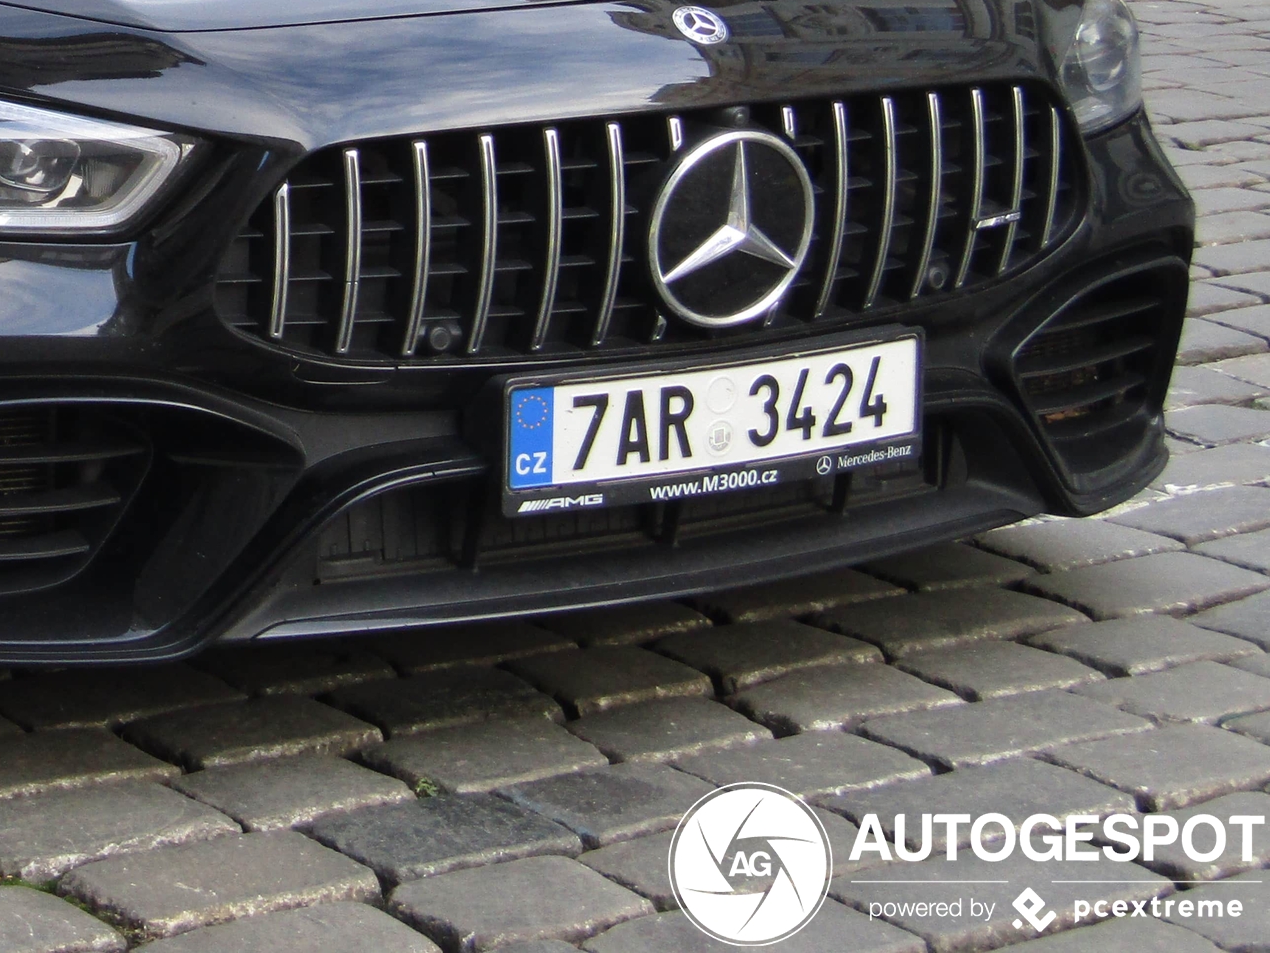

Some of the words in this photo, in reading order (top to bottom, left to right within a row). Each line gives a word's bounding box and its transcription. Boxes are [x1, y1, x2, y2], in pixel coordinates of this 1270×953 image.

[572, 384, 695, 470] 7AR
[747, 356, 888, 448] 3424
[516, 451, 547, 475] CZ
[837, 444, 912, 469] Mercedes-Benz
[650, 468, 778, 500] www.M3000.cz
